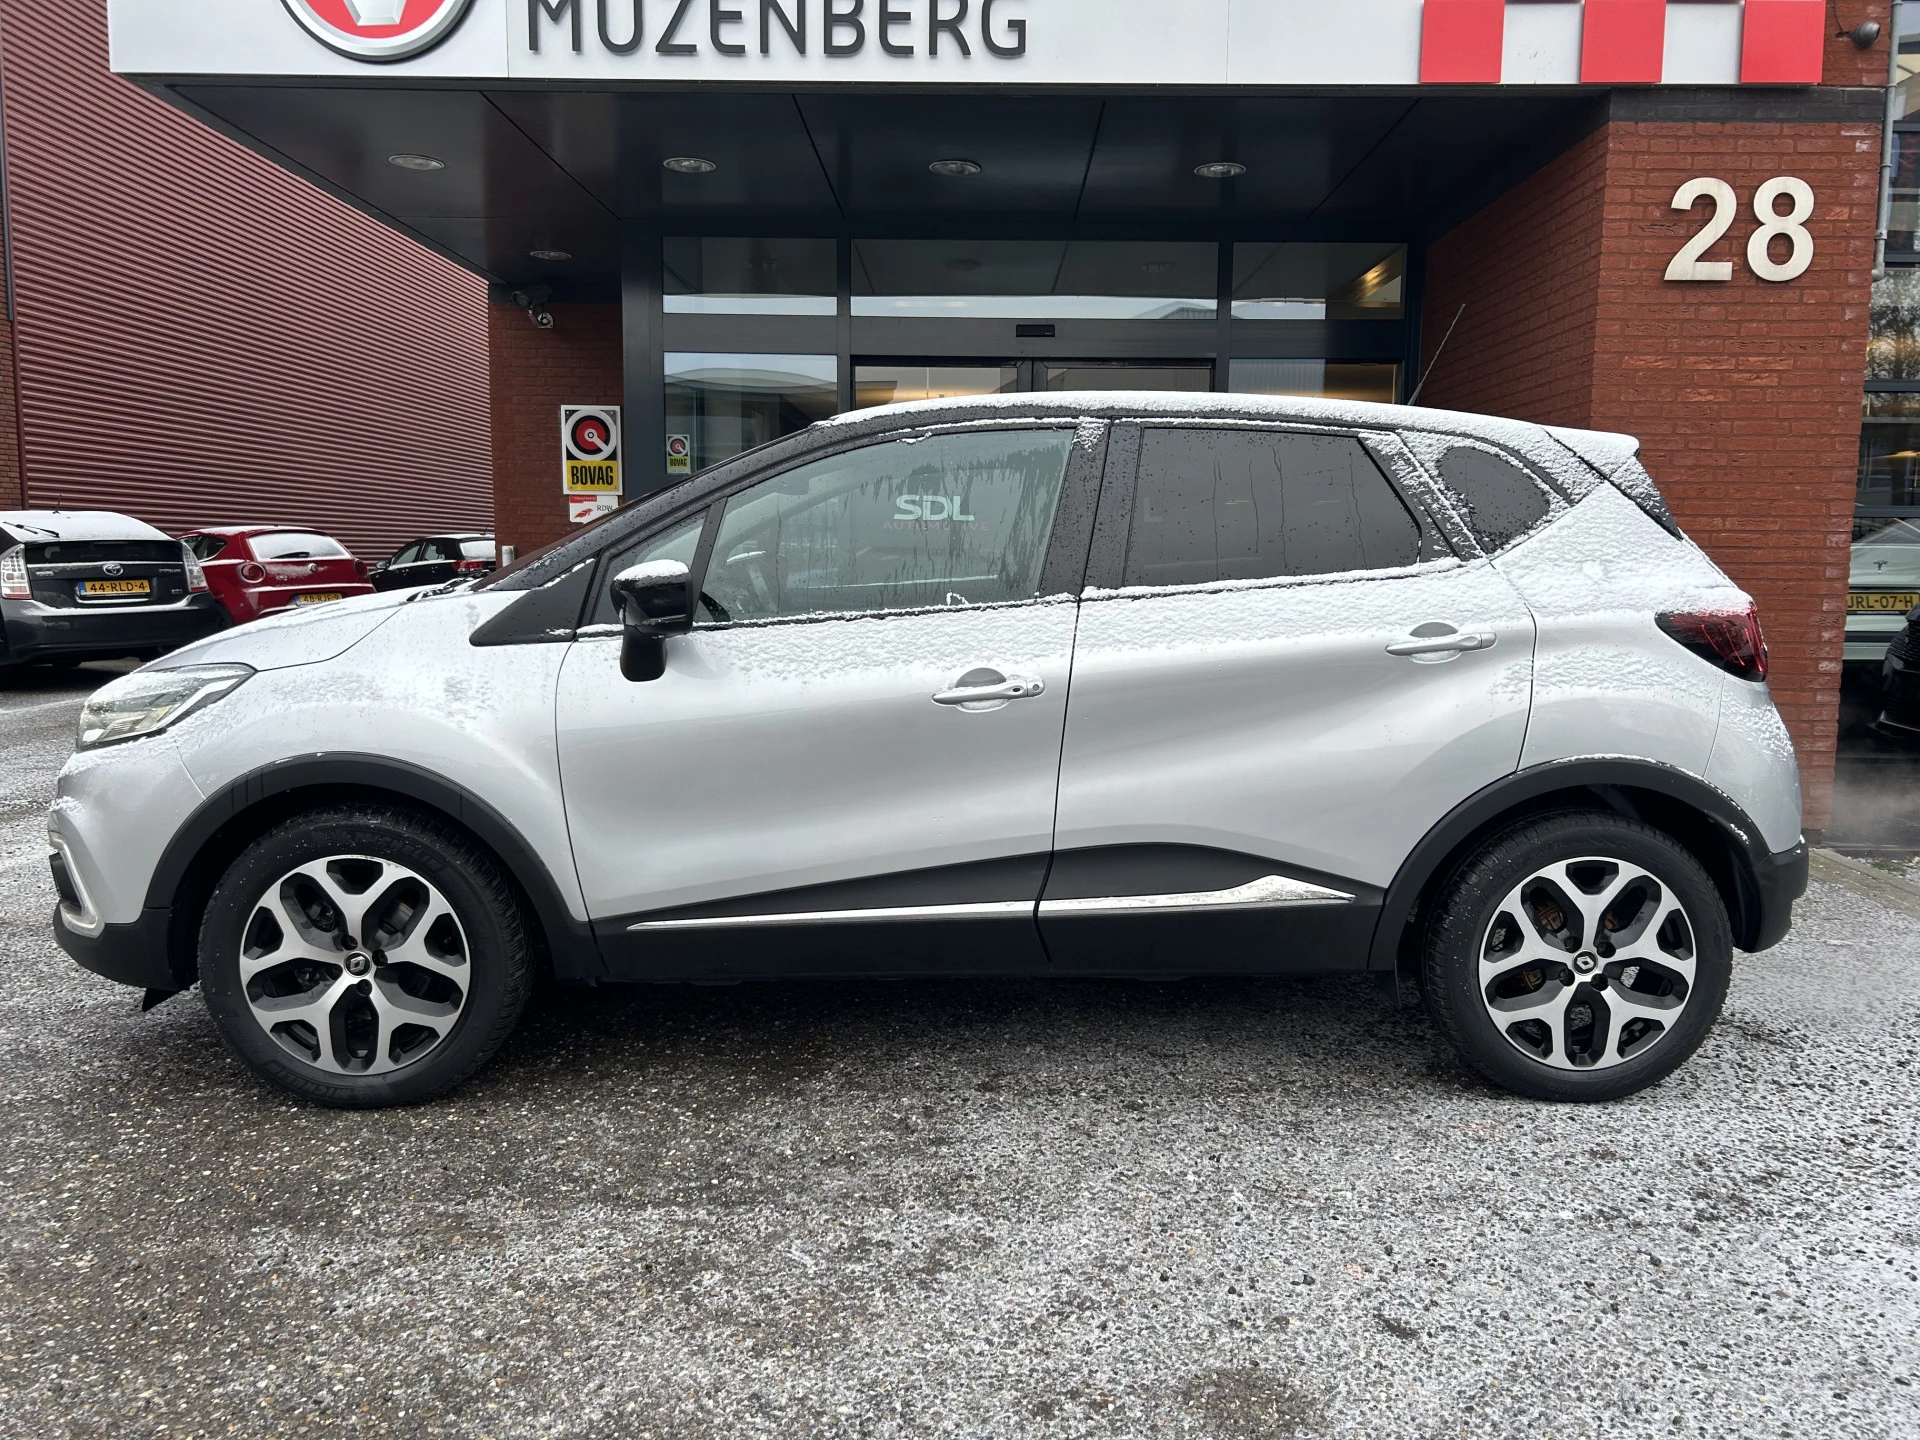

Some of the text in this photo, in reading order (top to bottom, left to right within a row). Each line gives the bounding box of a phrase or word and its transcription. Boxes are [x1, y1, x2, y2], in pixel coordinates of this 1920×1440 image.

[528, 0, 1027, 57] MUZENBERG
[1663, 176, 1815, 282] 28
[669, 457, 688, 467] BOVAG
[570, 465, 614, 486] BOVAG
[596, 504, 613, 512] RDW
[893, 494, 975, 521] SDL
[89, 581, 149, 593] 44-RLD-4
[1847, 595, 1914, 608] JRL-07-H
